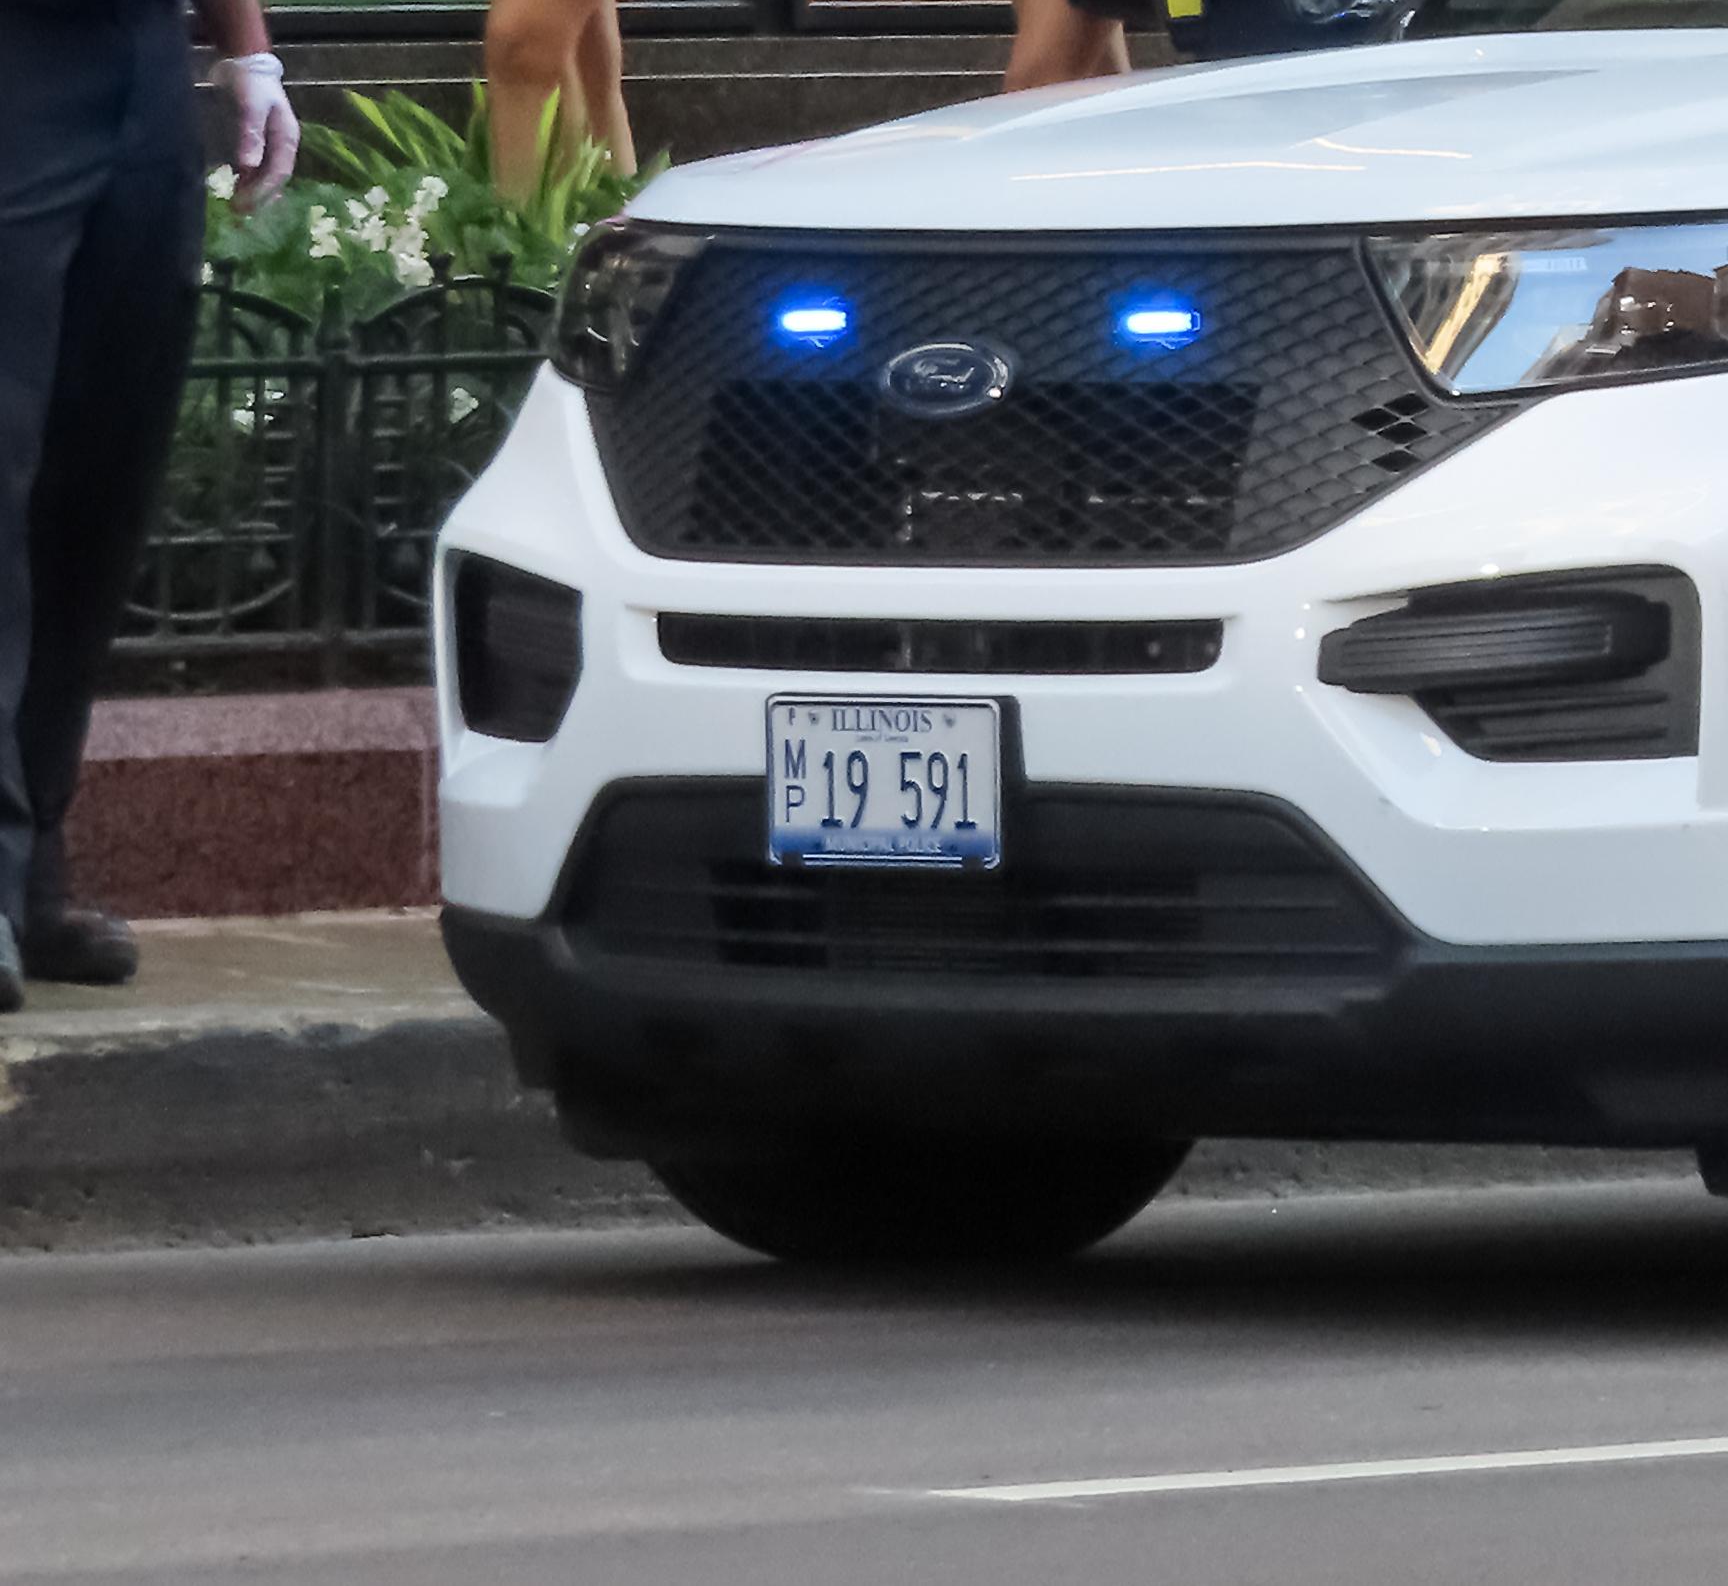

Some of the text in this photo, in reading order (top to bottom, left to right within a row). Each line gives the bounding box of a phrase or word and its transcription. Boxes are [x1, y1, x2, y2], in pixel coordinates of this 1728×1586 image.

[831, 707, 933, 734] ILLINOIS
[821, 750, 977, 830] 19 591
